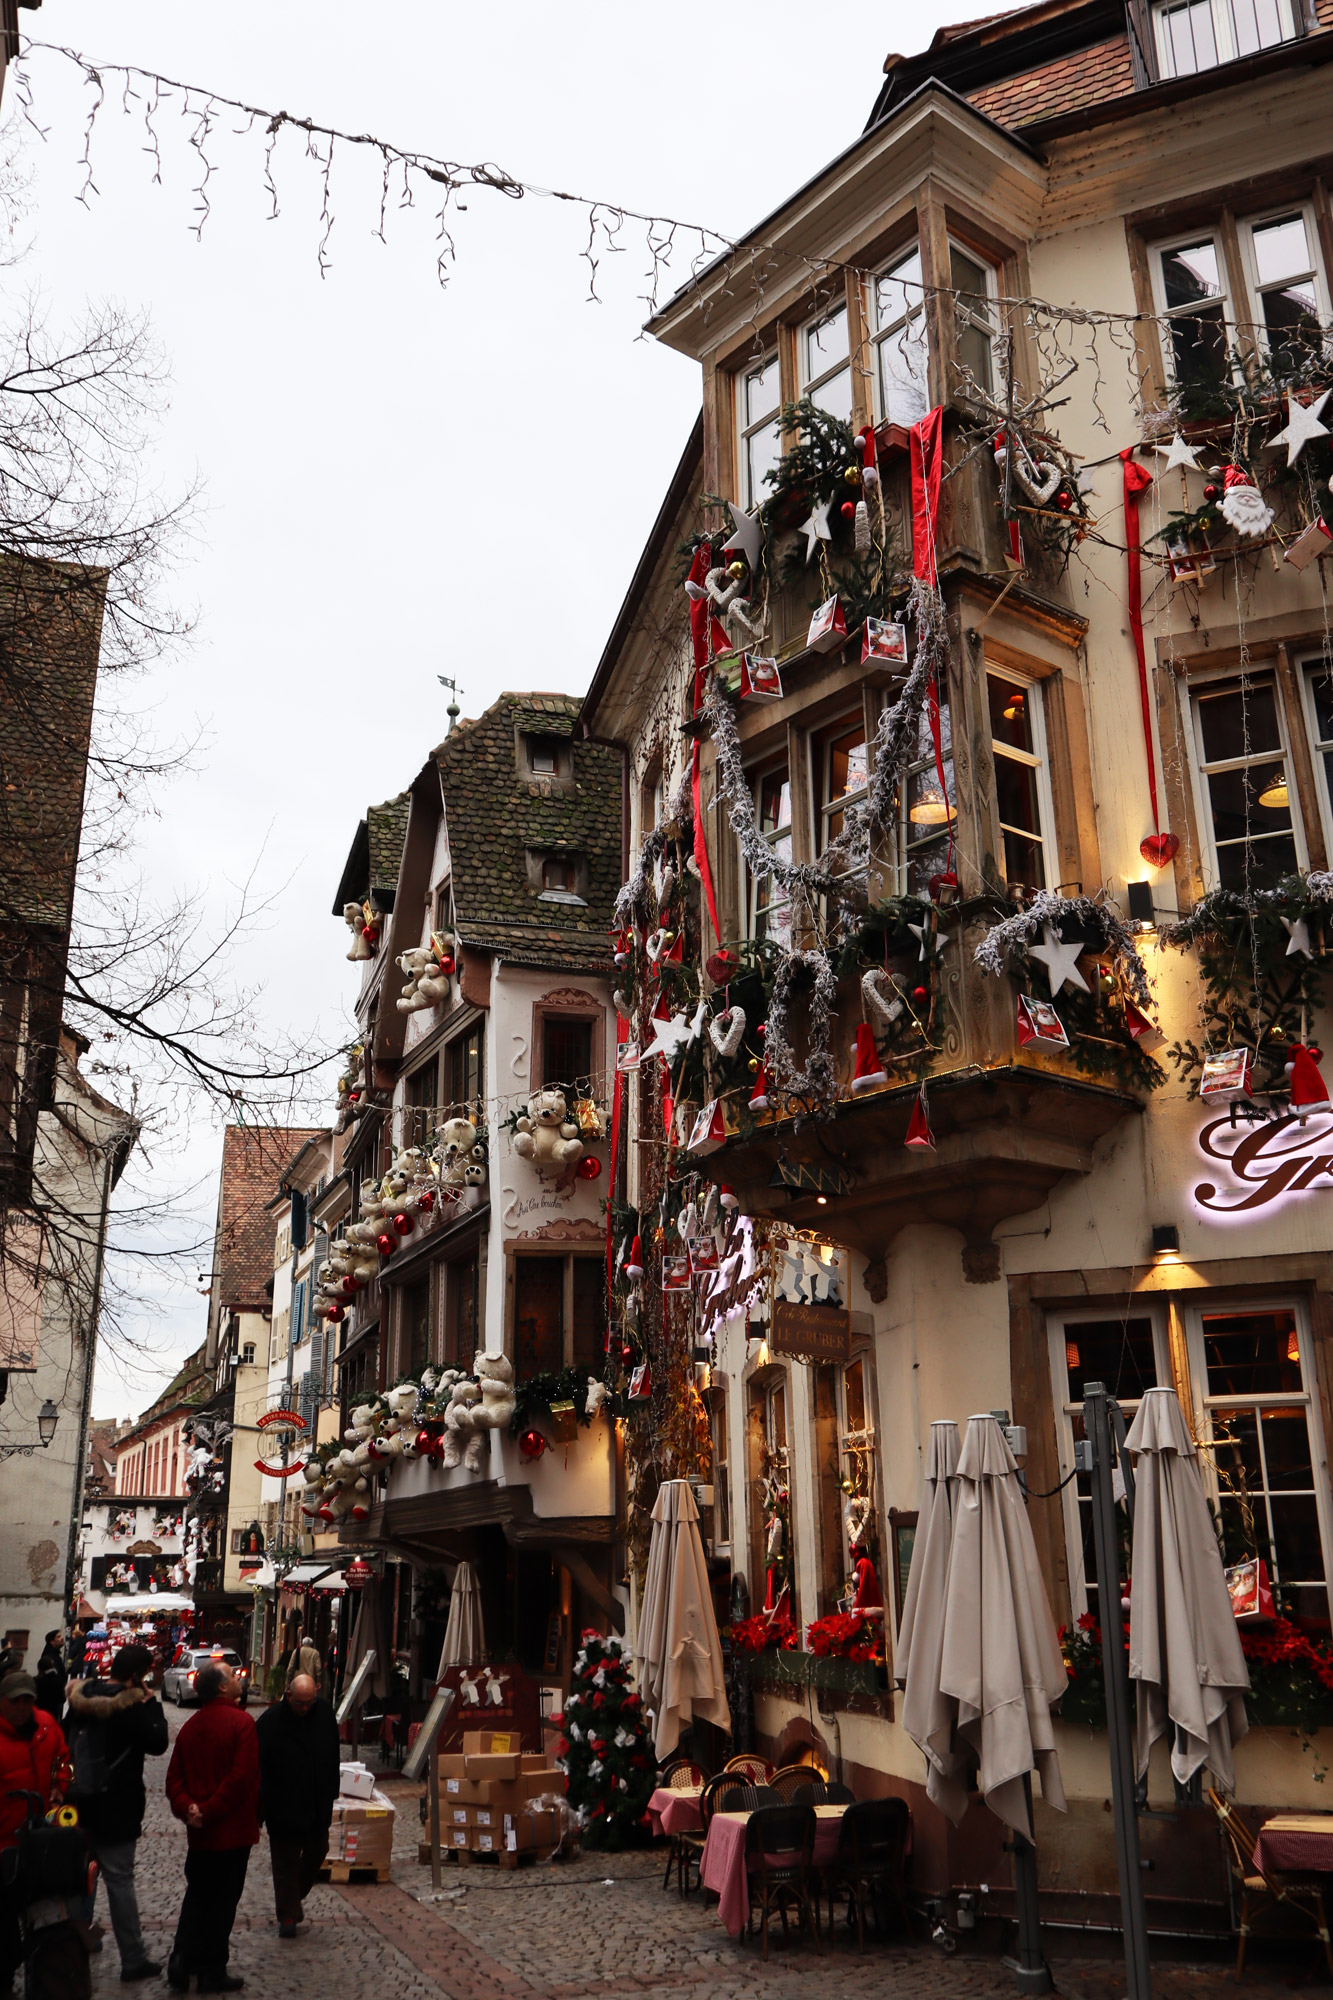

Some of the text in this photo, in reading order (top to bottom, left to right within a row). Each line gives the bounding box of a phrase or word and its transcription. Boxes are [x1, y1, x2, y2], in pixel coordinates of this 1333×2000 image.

[777, 1327, 846, 1350] LE GRUBER
[266, 1413, 279, 1421] TIRE
[279, 1412, 306, 1427] BOUCHON
[263, 1467, 295, 1476] WINSTUB
